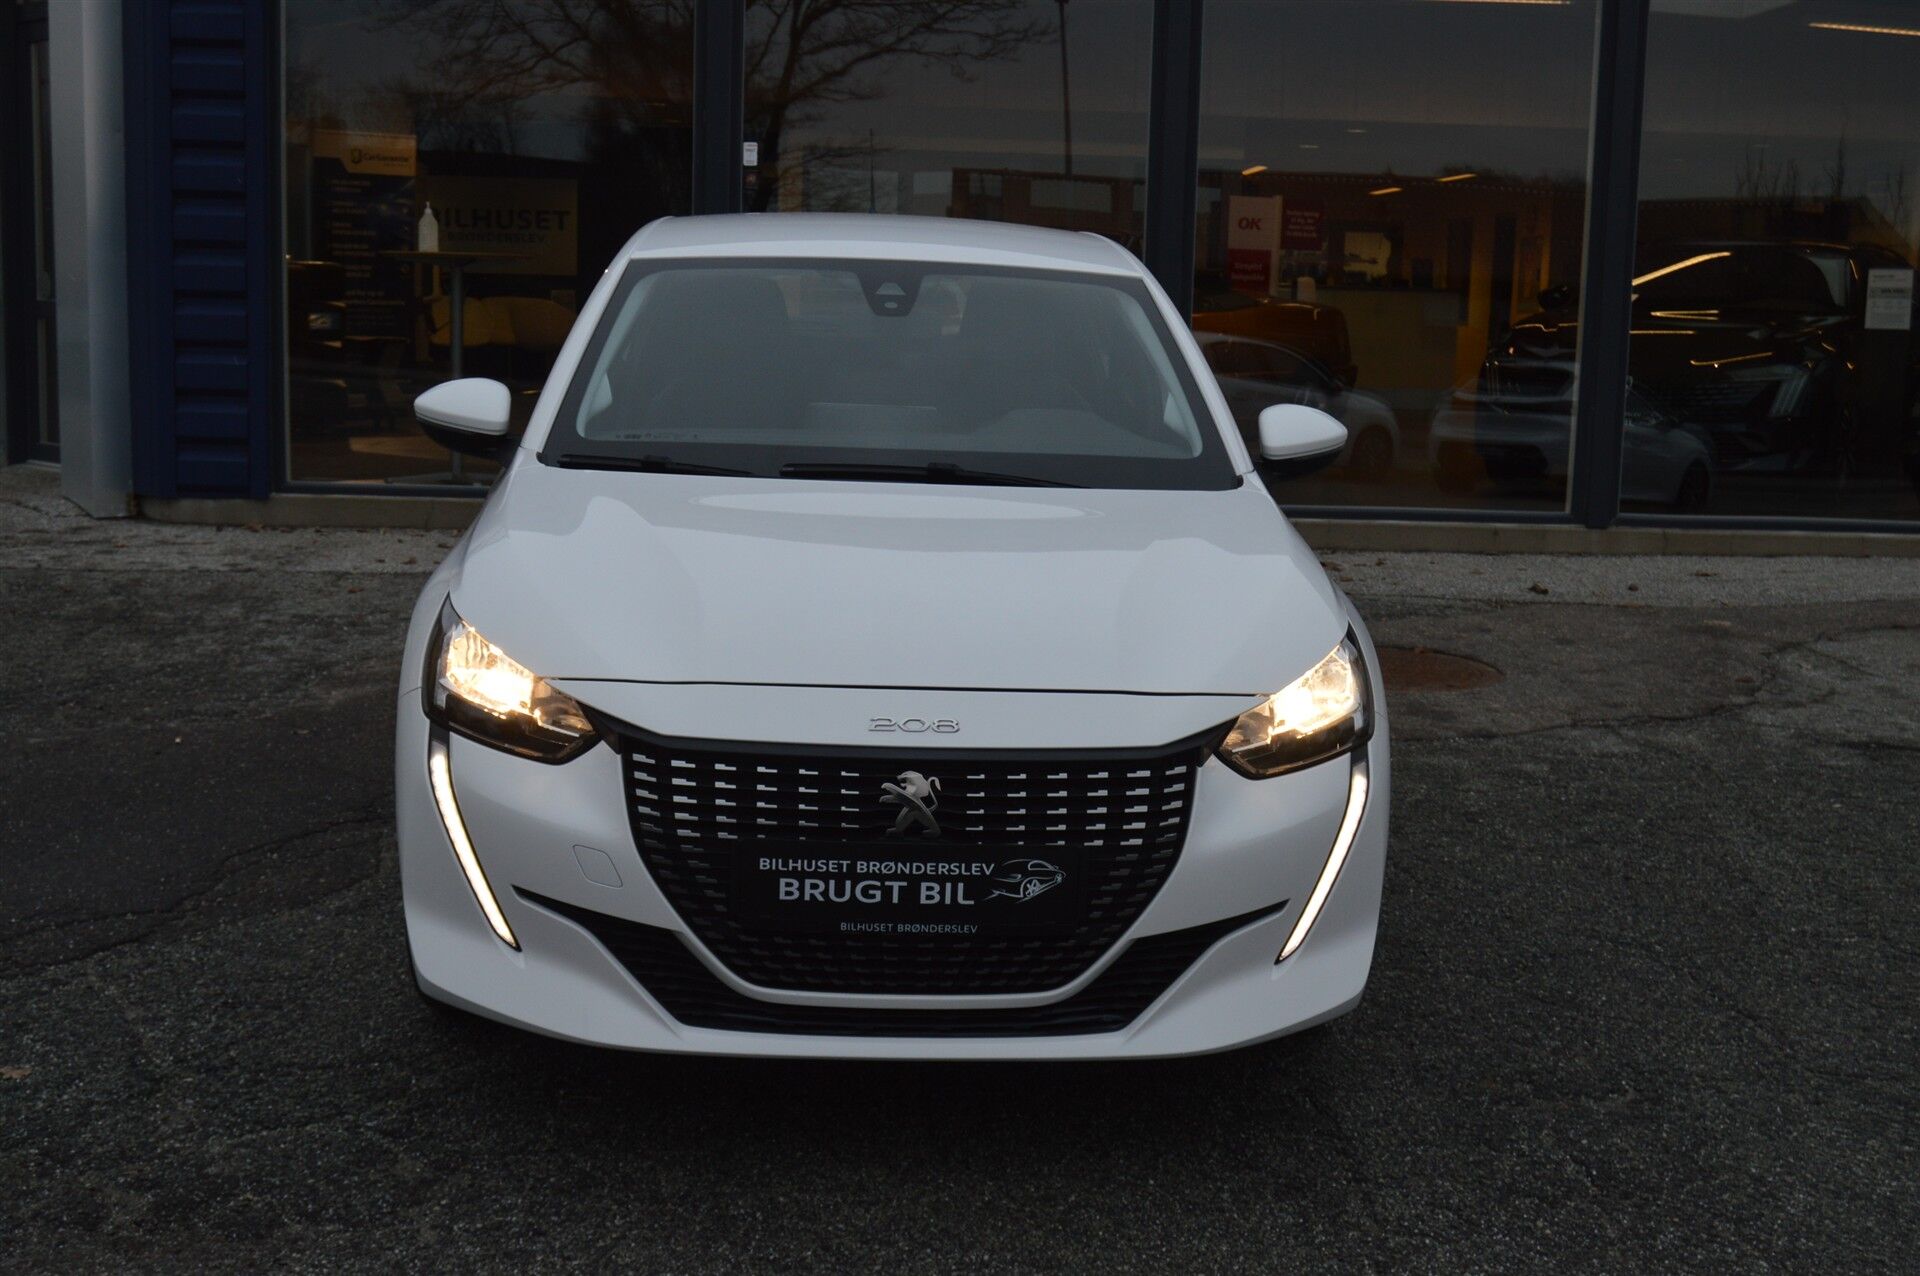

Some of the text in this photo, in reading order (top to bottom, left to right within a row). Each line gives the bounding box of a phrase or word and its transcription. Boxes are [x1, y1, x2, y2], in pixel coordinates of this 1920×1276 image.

[1238, 217, 1262, 231] OK
[868, 717, 960, 733] 208
[759, 858, 995, 876] BILHUSET BRØNDERSLEV
[779, 878, 975, 905] BRUGT BIL
[840, 922, 978, 934] BILHUSET BRØNDERSLEV
